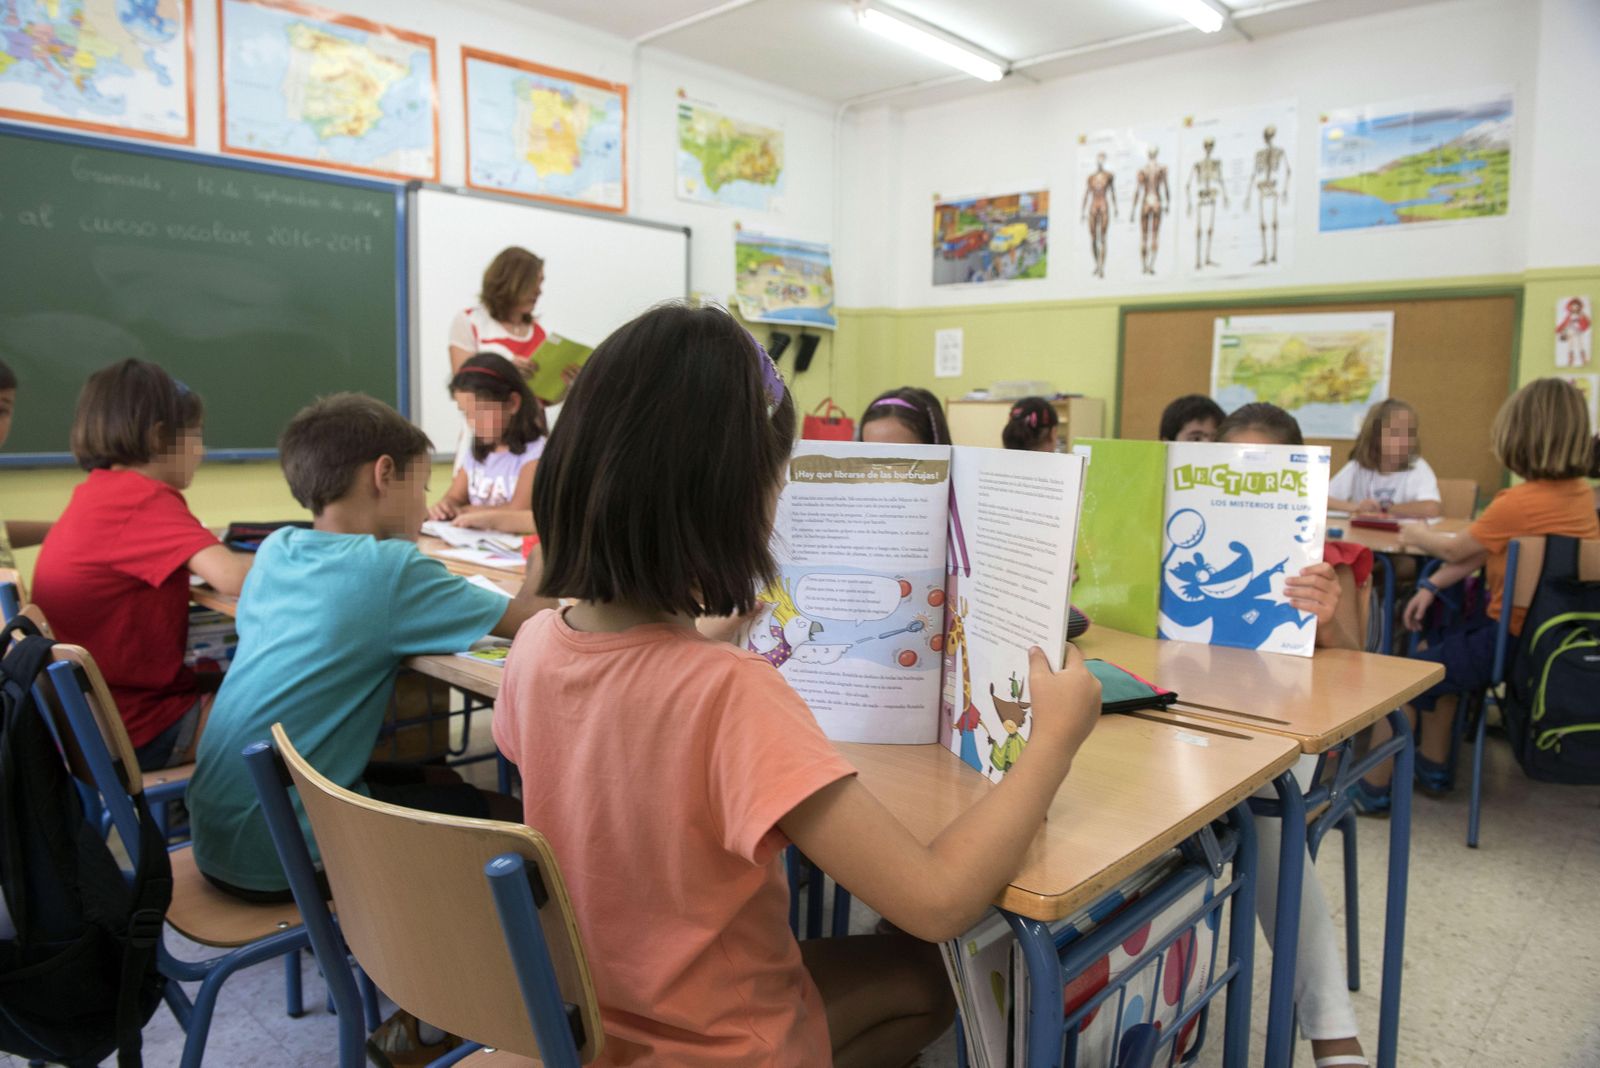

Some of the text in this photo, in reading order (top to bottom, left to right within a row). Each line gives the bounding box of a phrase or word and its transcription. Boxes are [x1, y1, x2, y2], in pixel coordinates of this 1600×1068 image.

[794, 470, 814, 480] ¡Hay
[816, 472, 833, 480] que
[834, 470, 866, 479] librarse
[867, 470, 878, 479] de
[880, 470, 893, 479] las
[1211, 499, 1227, 507] LOS
[1229, 501, 1274, 510] MISTERIOS
[1277, 502, 1290, 511] DE
